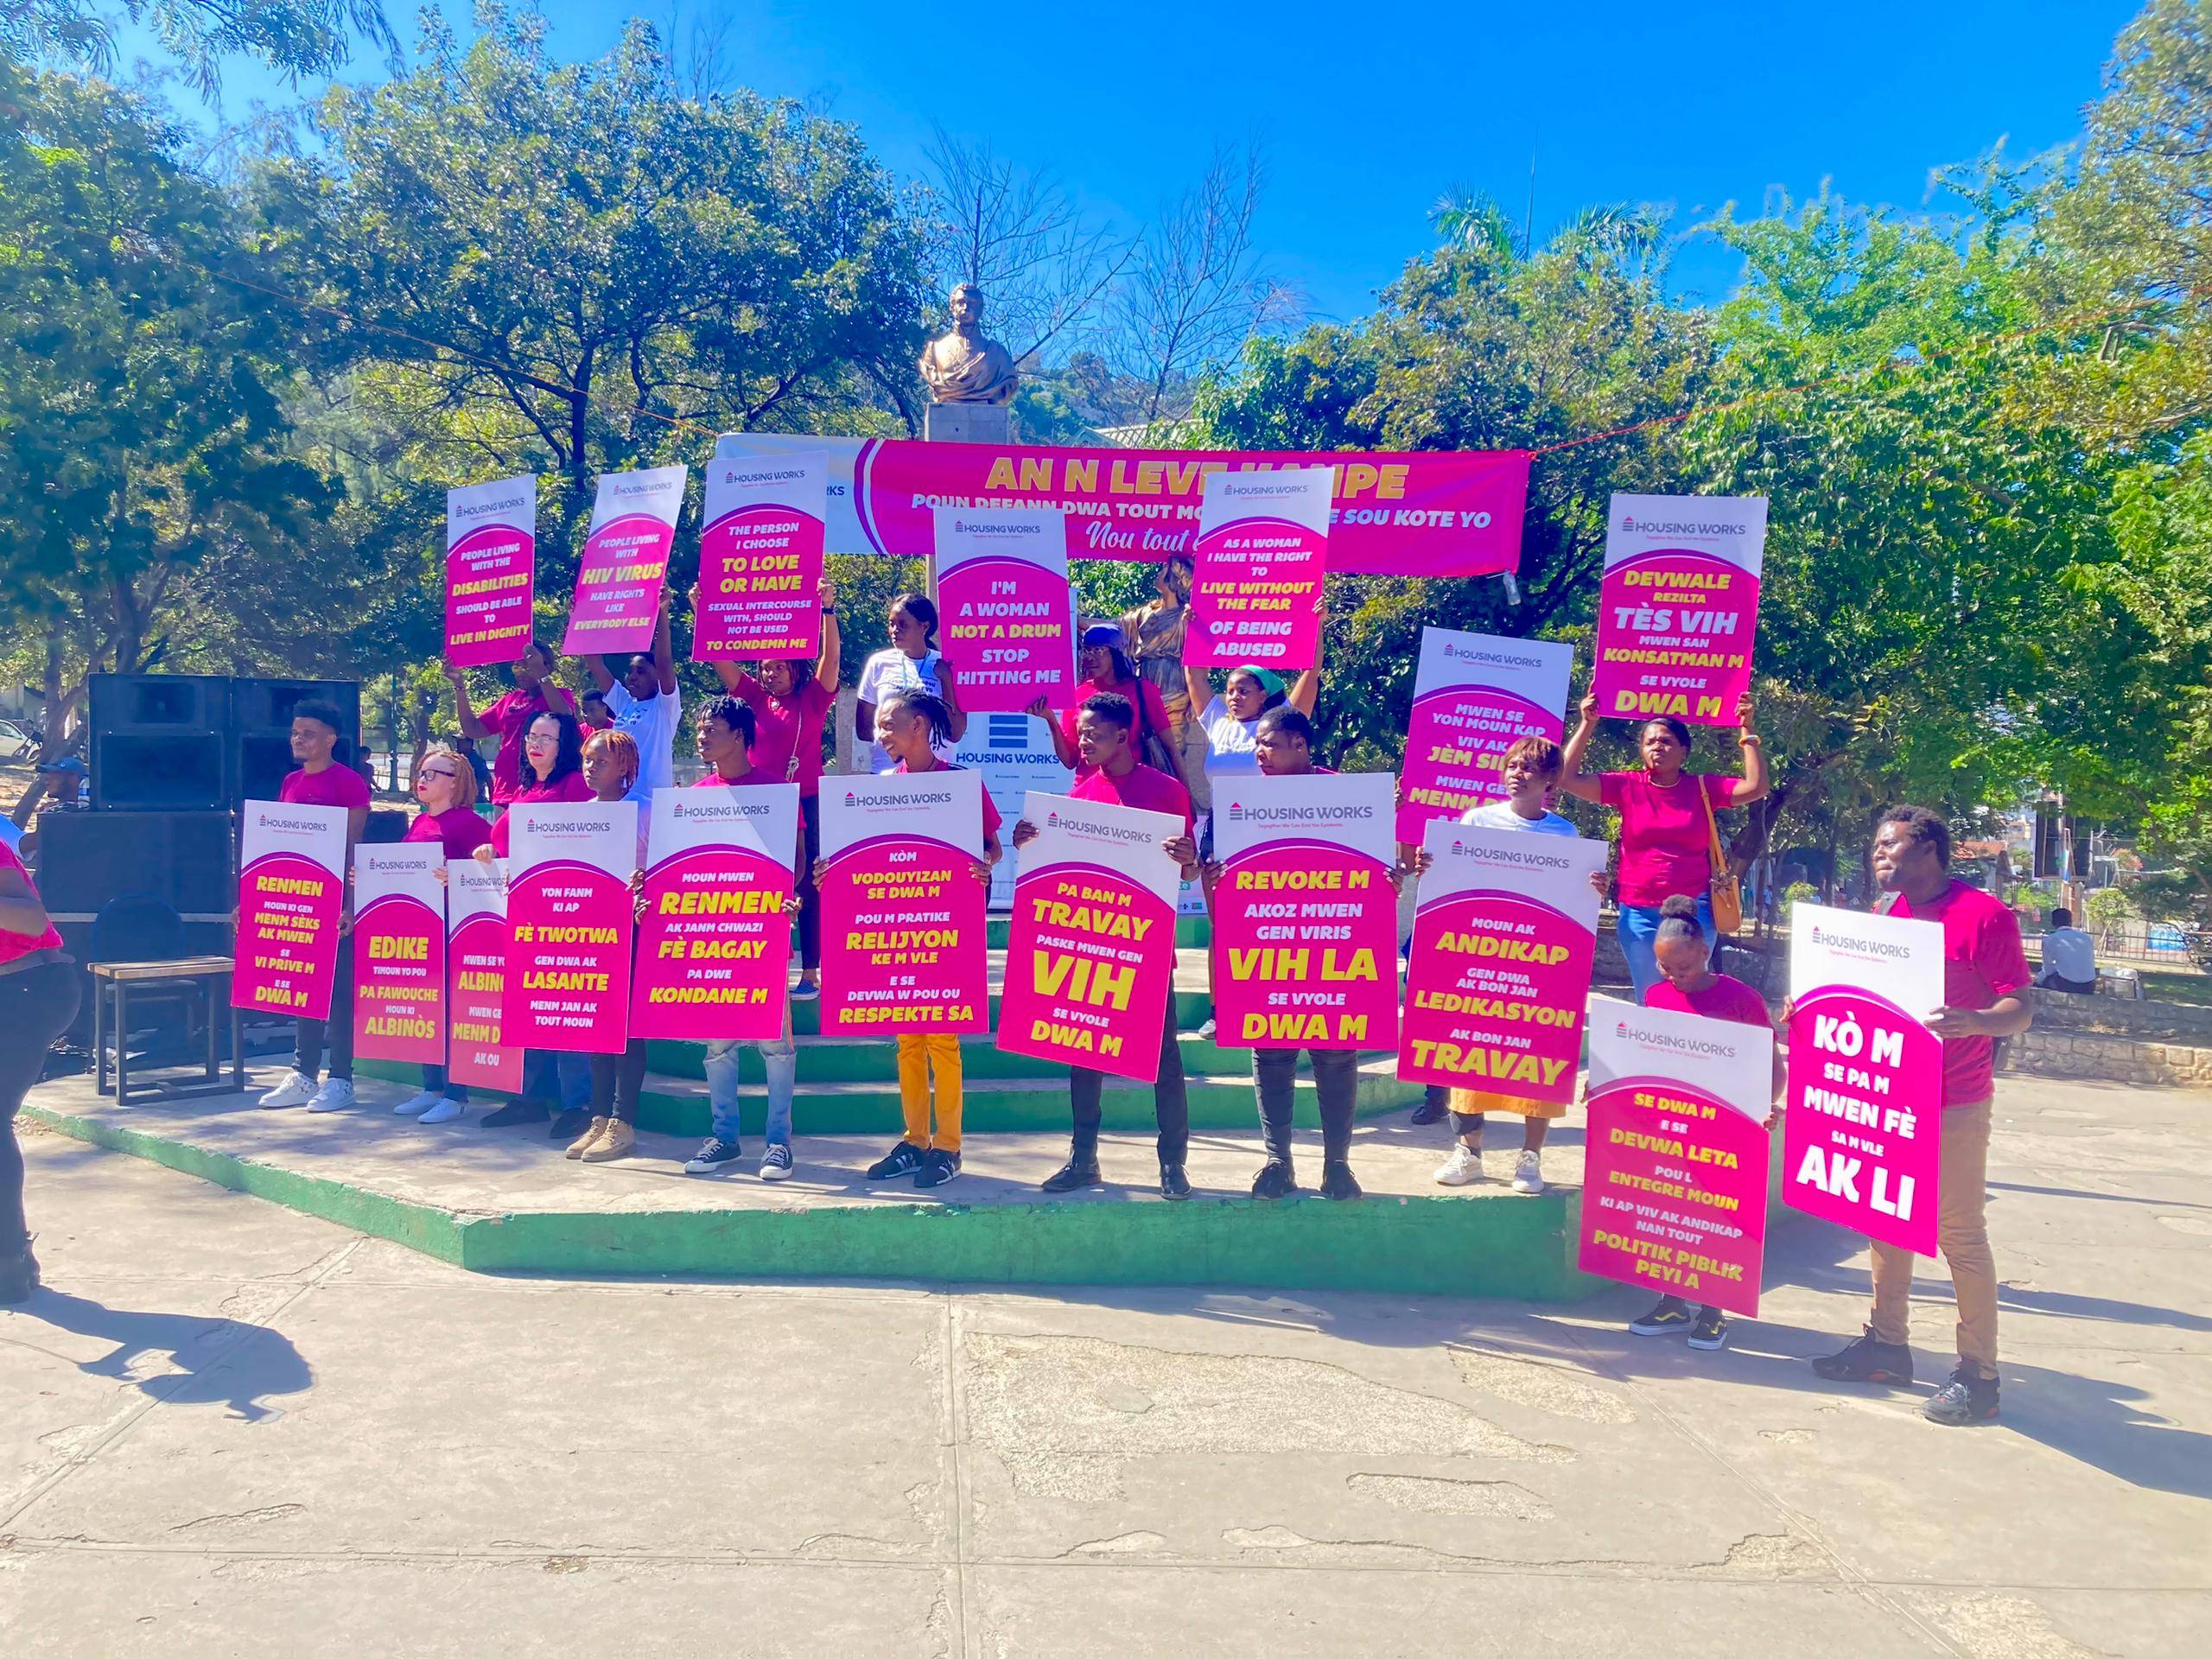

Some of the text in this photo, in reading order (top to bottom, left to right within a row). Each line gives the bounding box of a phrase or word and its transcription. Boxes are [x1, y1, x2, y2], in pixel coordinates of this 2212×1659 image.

[734, 470, 804, 482] HOUSING WORKS
[985, 457, 1053, 491] AN
[1065, 459, 1099, 493] N
[463, 498, 524, 516] HOUSING WORKS
[911, 493, 969, 510] POUN
[1063, 501, 1110, 517] DWA
[1120, 502, 1172, 518] TOUT
[1343, 508, 1384, 525] SOU
[1394, 510, 1455, 527] KOTE
[1461, 512, 1491, 528] YO
[1636, 523, 1745, 534] HOUSING WORKS
[1142, 530, 1186, 551] tout
[461, 543, 519, 561] PEOPLE LIVING
[582, 563, 664, 584] HIV VIRUS
[1252, 567, 1268, 575] TO
[1624, 570, 1732, 589] DEVWALE
[453, 573, 528, 596] DISABILITIES
[992, 582, 1016, 594] I'M
[1201, 582, 1314, 594] LIVE WITHOUT
[590, 589, 645, 601] HAVE RIGHTS
[1217, 599, 1291, 609] THE FEAR
[1654, 593, 1706, 603] REZILTA
[606, 604, 624, 613] LIKE
[746, 601, 811, 610] INTERCOURSE
[485, 614, 495, 623] TO
[575, 618, 650, 630] EVERYBODY ELSE
[1615, 602, 1738, 634] TÈS VIH
[451, 624, 530, 645] LIVE IN DIGNITY
[951, 625, 1060, 638] NOT A DRUM
[707, 639, 807, 650] TO CONDEMN ME
[1213, 643, 1286, 656] ABUSED
[982, 649, 1029, 663] STOP
[1455, 650, 1502, 663] HOUSING
[1504, 656, 1541, 667] WORKS
[1604, 648, 1744, 668] KONSATMAN M
[957, 670, 1060, 684] HITTING ME
[1615, 690, 1721, 717] DWA M
[1433, 713, 1546, 736] YON MOUN KAP
[957, 753, 1059, 764] HOUSING WORKS
[1427, 744, 1472, 766] JÈM
[857, 793, 951, 806] HOUSING WORKS
[1409, 787, 1477, 810] MENM
[1245, 806, 1372, 820] HOUSING WORKS
[267, 819, 327, 831] HOUSING WORKS
[1059, 819, 1109, 836] HOUSING
[1111, 827, 1151, 842] WORKS
[889, 850, 917, 861] KÒM
[257, 876, 323, 897] RENMEN
[466, 878, 492, 887] HOUSING
[852, 870, 951, 884] VODOUYIZAN
[542, 888, 593, 897] YON FANM
[659, 891, 783, 914] RENMEN
[255, 912, 320, 930] MENM SÈKS
[1033, 899, 1153, 940] TRAVAY
[1471, 918, 1535, 935] MOUN AK
[515, 923, 618, 944] FÈ TWOTWA
[846, 930, 958, 950] RELIJYON
[369, 937, 429, 959] EDIKE
[658, 936, 767, 958] FÈ BAGAY
[1037, 935, 1142, 963] PASKE MWEN GEN
[1435, 931, 1569, 965] ANDIKAP
[1821, 933, 1866, 951] HOUSING
[1869, 942, 1910, 958] WORKS
[256, 957, 315, 973] VI PRIVE M
[1229, 949, 1377, 980] VIH LA
[459, 971, 504, 991] ALBIN
[524, 971, 608, 990] LASANTE
[1033, 950, 1136, 1011] VIH
[256, 986, 308, 1007] DWA M
[360, 986, 438, 1001] PA FAWOUCHE
[650, 988, 767, 1003] KONDANE M
[1268, 993, 1345, 1005] SE VYOLE
[839, 1006, 973, 1023] RESPEKTE SA
[1414, 990, 1576, 1027] LEDIKASYON
[365, 1015, 435, 1038] ALBINÒS
[454, 1023, 489, 1042] MENM
[1243, 1014, 1367, 1039] DWA M
[1814, 1011, 1904, 1067] KÒ M
[474, 1052, 499, 1065] AK OU
[1411, 1039, 1568, 1086] TRAVAY
[1804, 1085, 1916, 1139] MWEN FÈ
[1611, 1128, 1738, 1169] DEVWA LETA
[1832, 1131, 1884, 1156] SA M VLE
[1610, 1171, 1738, 1211] ENTEGRE MOUN
[1796, 1145, 1915, 1221] AK LI
[1593, 1230, 1743, 1281] POLITIK PIBLIK
[1636, 1260, 1699, 1289] PEYI A
